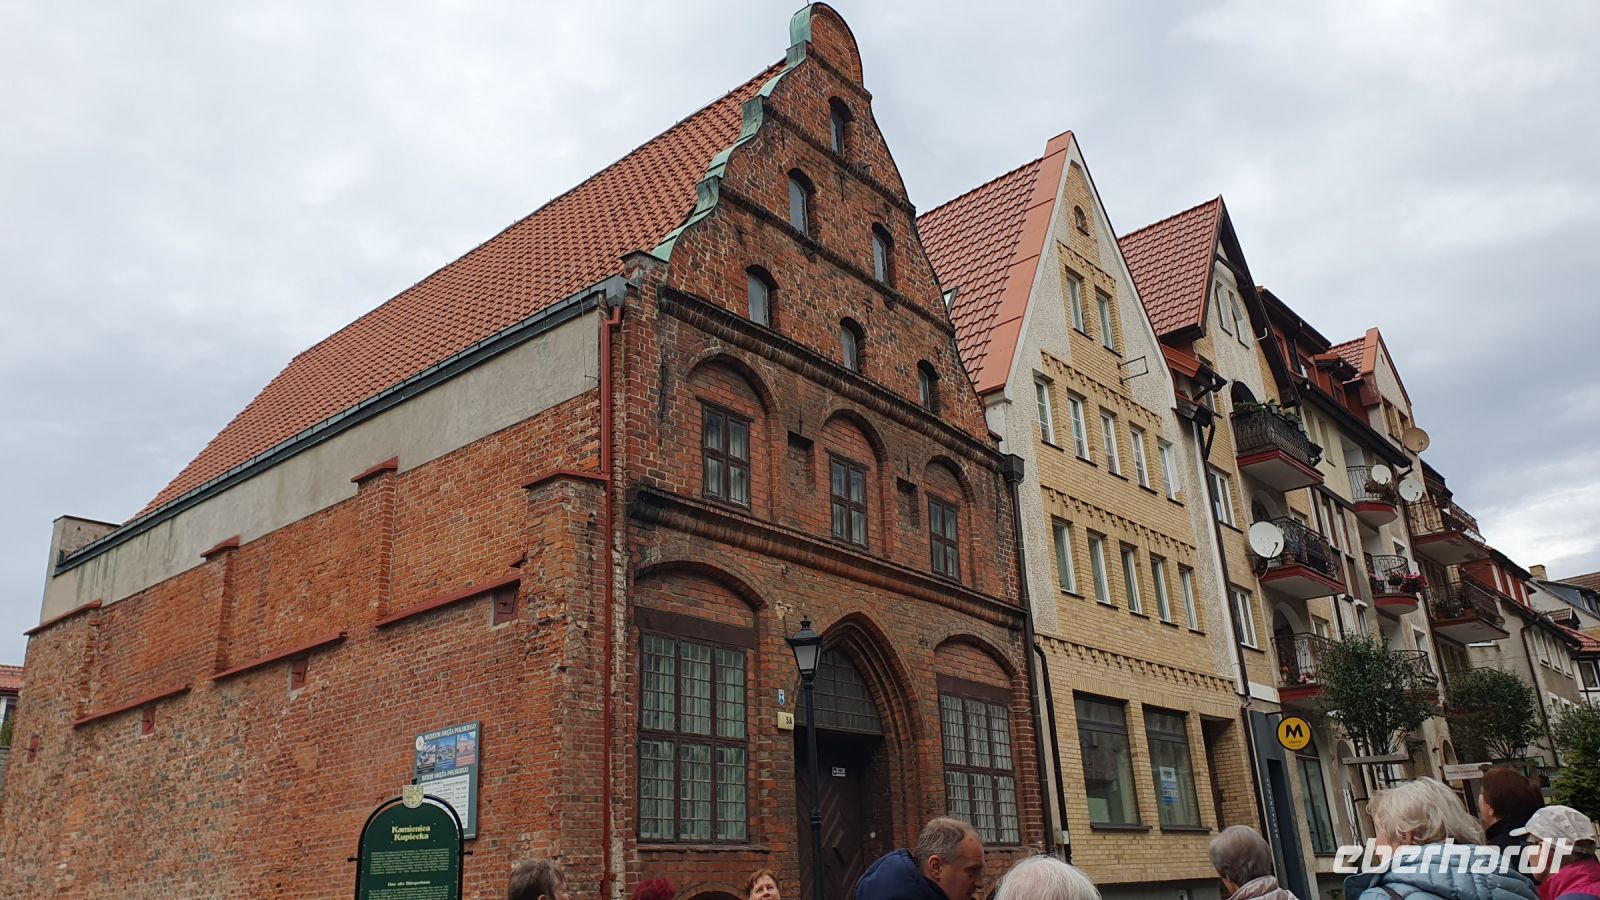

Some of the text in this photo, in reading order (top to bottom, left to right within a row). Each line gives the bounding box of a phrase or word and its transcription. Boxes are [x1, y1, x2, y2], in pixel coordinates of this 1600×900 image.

[1286, 724, 1303, 738] M
[391, 825, 430, 833] Kamienica
[394, 833, 429, 841] Kupiecka
